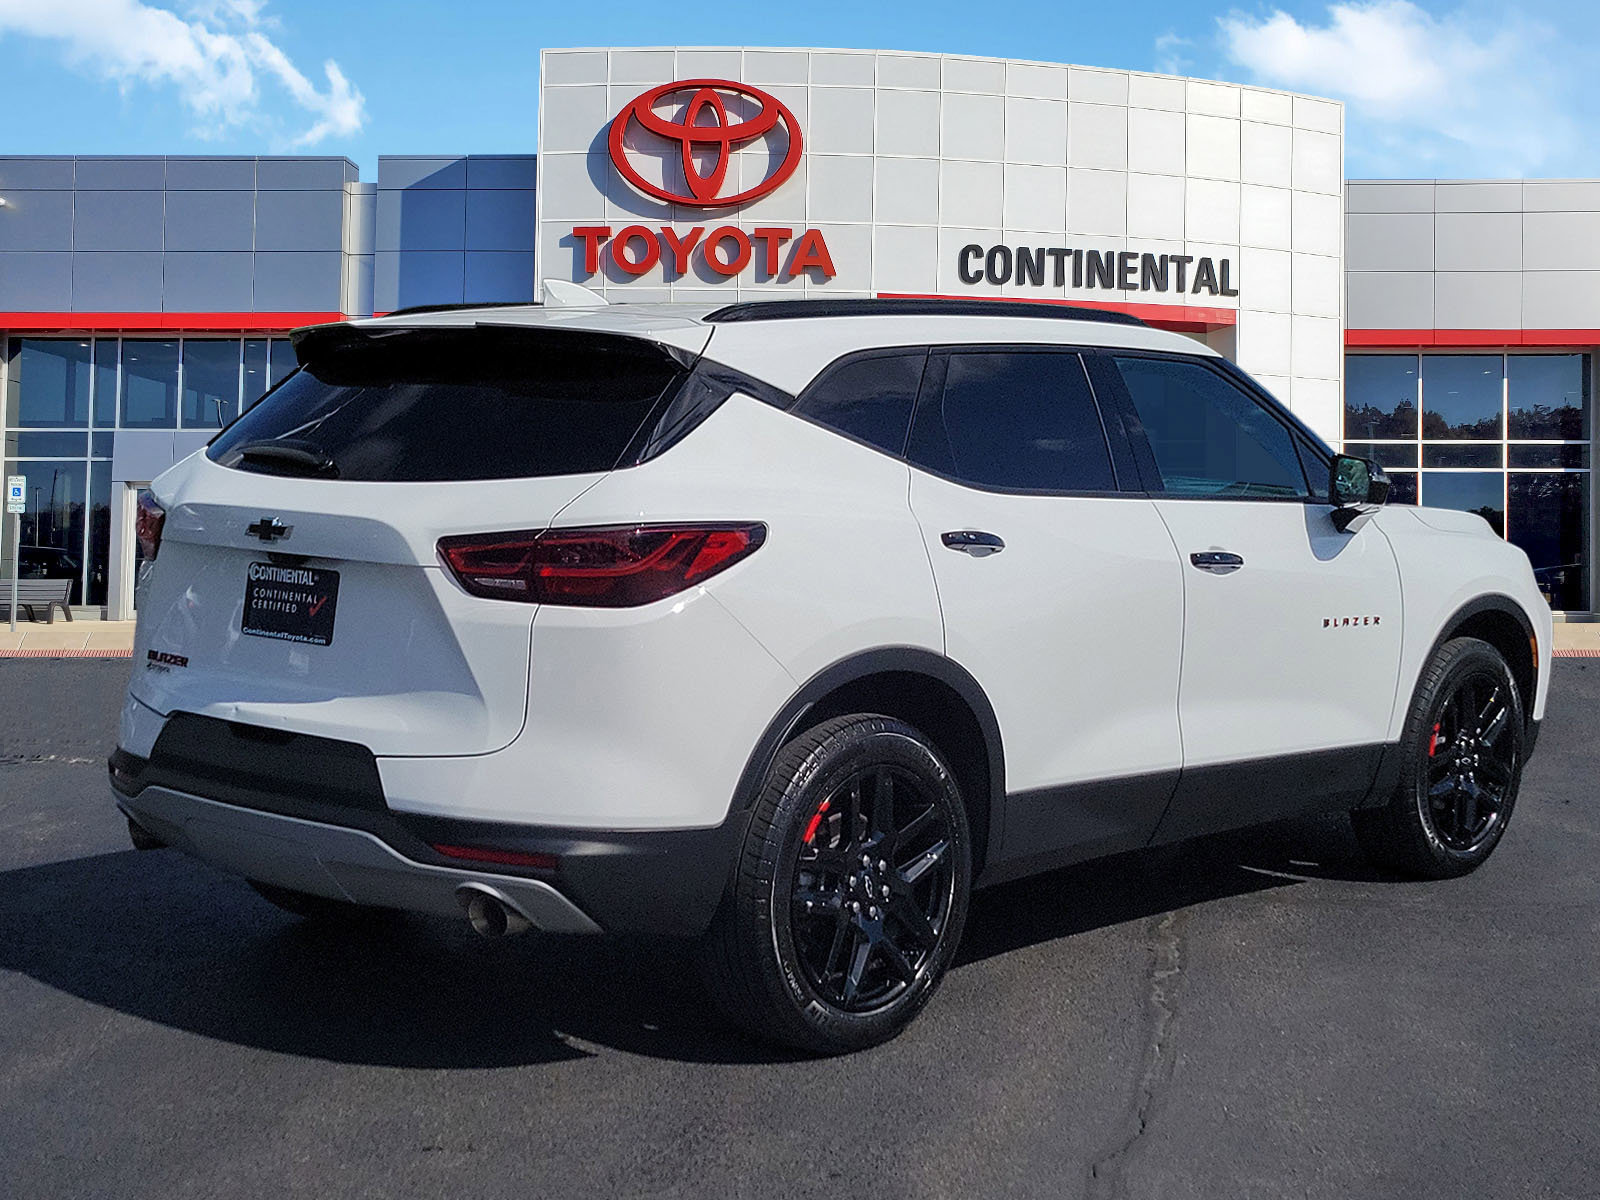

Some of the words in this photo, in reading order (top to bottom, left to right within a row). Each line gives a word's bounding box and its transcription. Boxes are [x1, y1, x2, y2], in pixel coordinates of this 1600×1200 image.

[572, 225, 836, 277] TOYOTA
[958, 244, 1239, 297] CONTINENTAL
[249, 563, 315, 586] CONTINENTAL
[253, 587, 318, 604] CONTINENTAL
[252, 599, 298, 613] CERTIFIED
[1323, 616, 1380, 628] BLAZER
[147, 649, 189, 668] BLAZER
